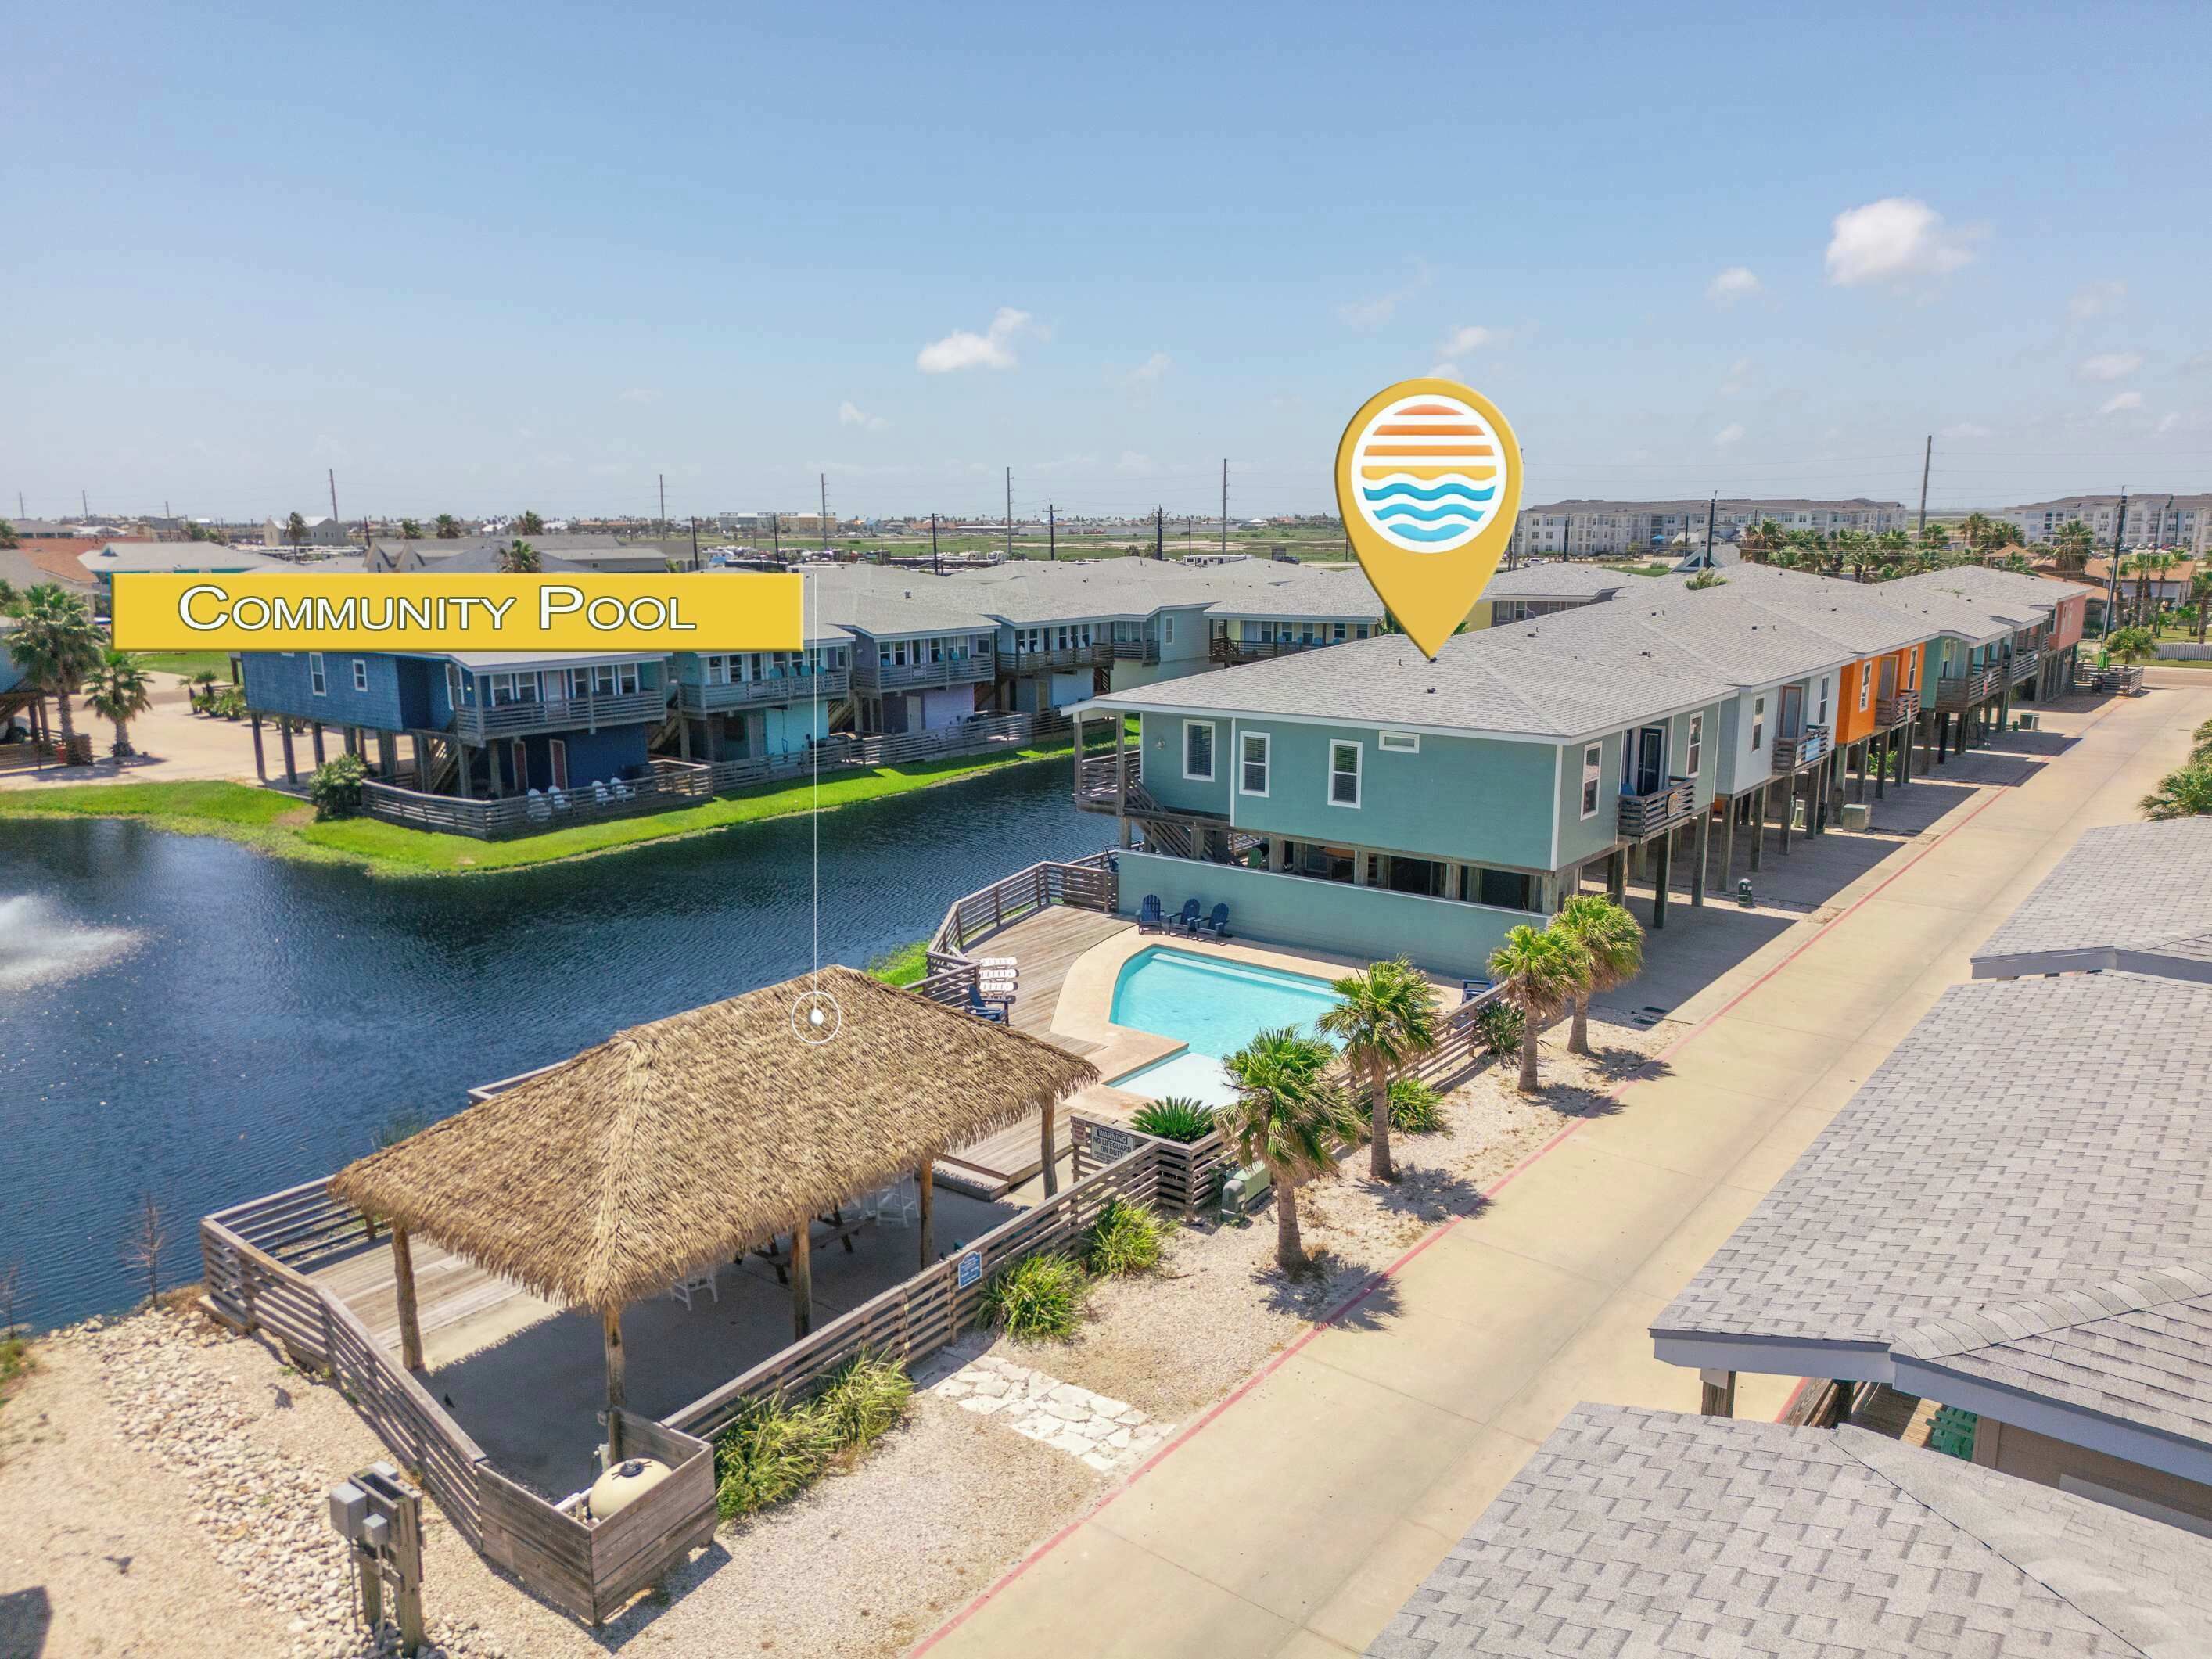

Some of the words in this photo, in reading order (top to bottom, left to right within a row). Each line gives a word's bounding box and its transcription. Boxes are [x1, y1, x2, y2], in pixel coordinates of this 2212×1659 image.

[1098, 1129, 1127, 1144] WARNING
[1101, 1145, 1108, 1154] ON
[1110, 1148, 1124, 1158] DUTY
[1102, 1139, 1132, 1153] LIFEGUARD
